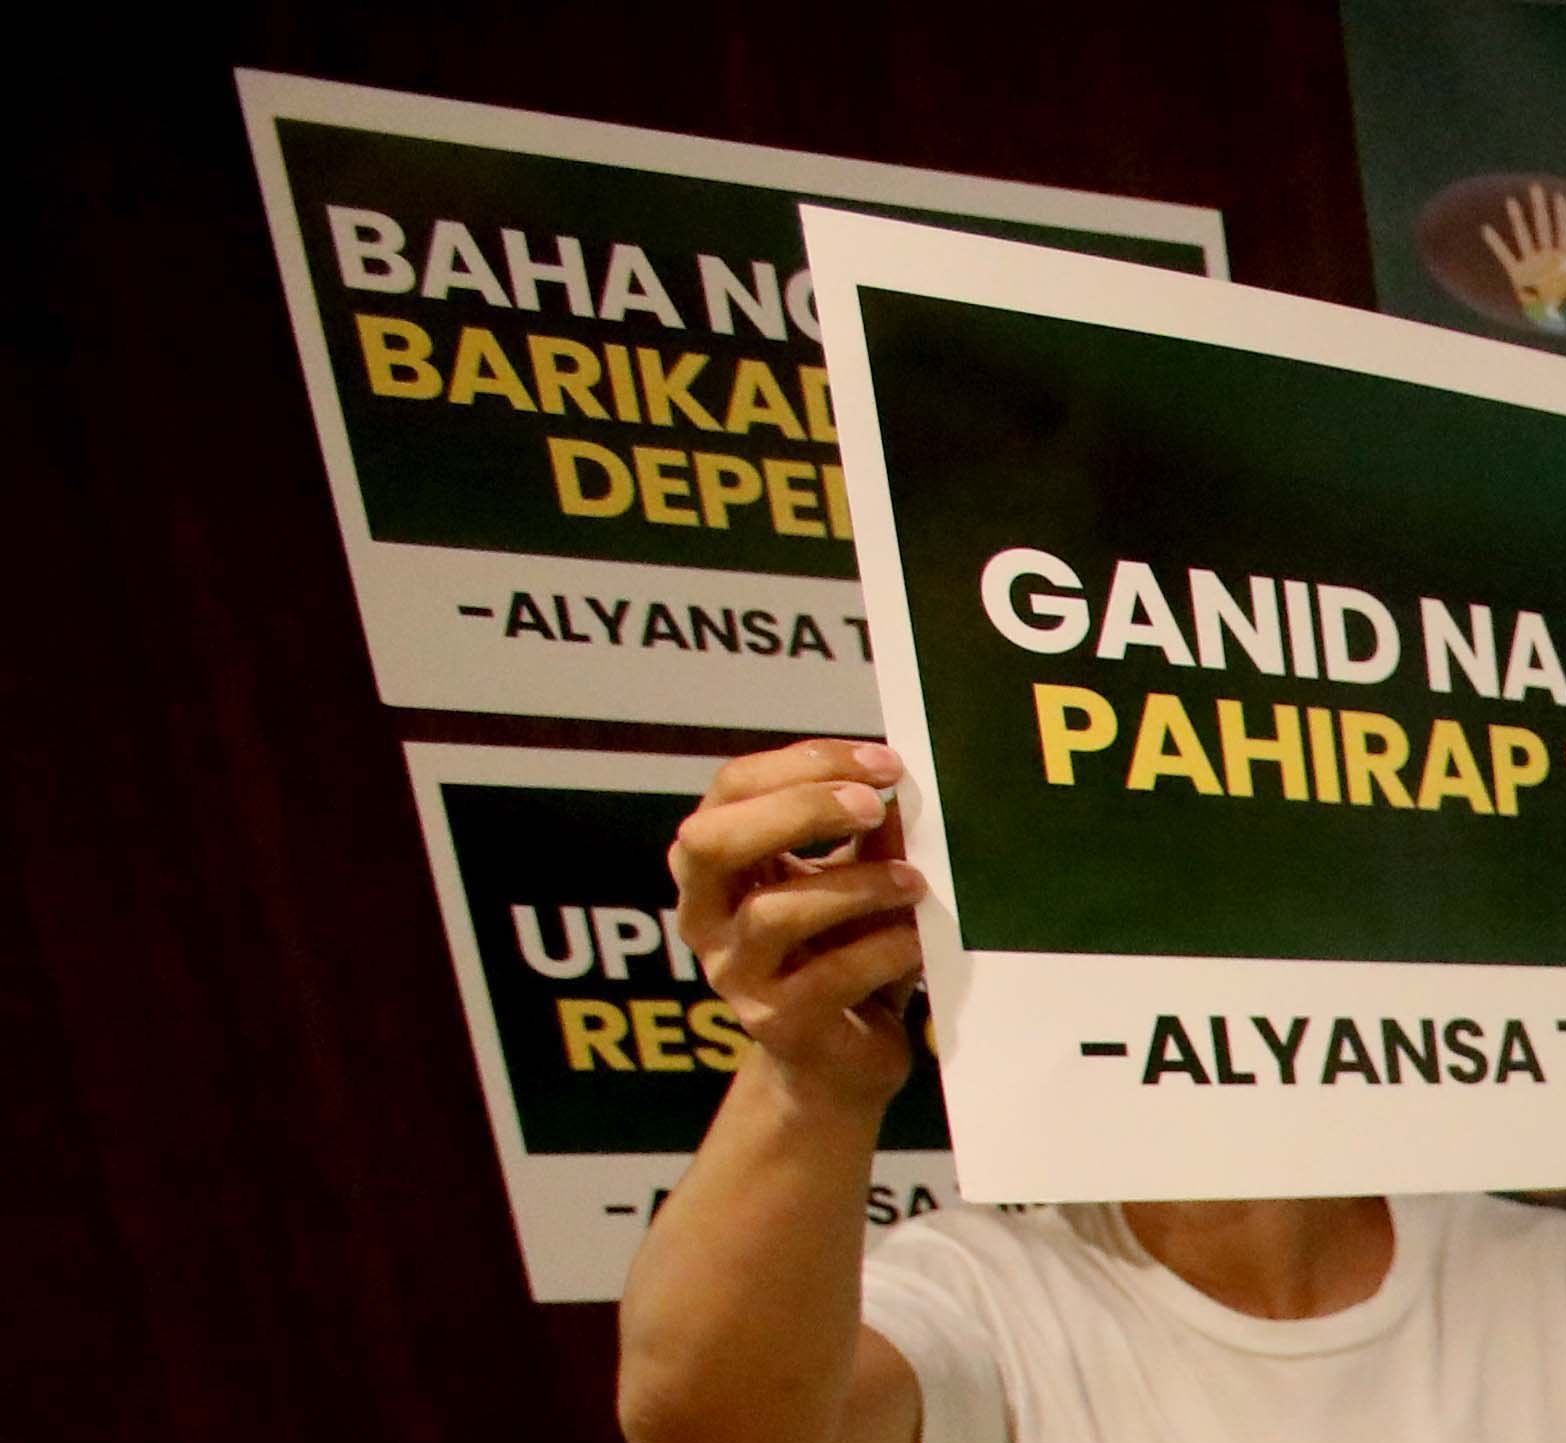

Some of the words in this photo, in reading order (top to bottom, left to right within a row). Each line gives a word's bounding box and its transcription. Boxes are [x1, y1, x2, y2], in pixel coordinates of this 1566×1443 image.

[326, 203, 678, 329] BAHA
[457, 591, 835, 662] -ALYANSA
[979, 546, 1400, 685] GANID
[1031, 682, 1549, 817] PAHIRAP
[510, 904, 697, 981] UP
[1079, 1013, 1546, 1088] -ALYANSA
